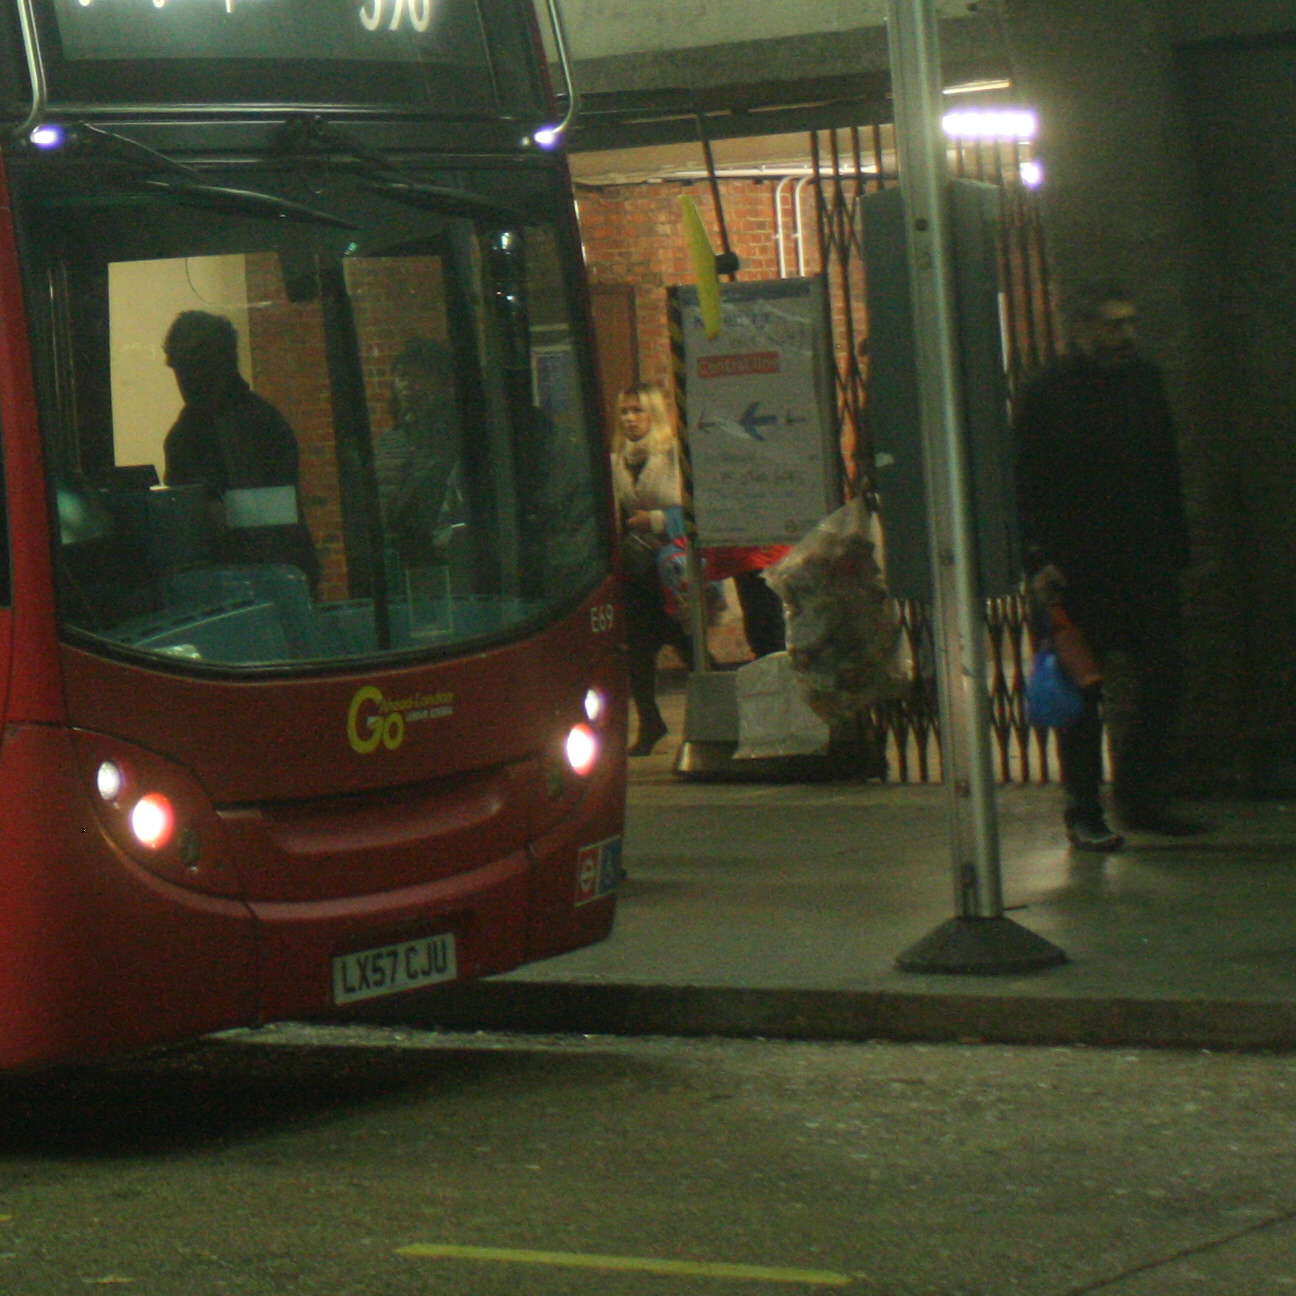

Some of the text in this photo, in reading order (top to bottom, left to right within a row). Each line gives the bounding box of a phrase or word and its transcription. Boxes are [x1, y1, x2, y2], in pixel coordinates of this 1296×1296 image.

[590, 604, 613, 634] E69
[348, 686, 404, 754] Go
[342, 937, 447, 994] LX57 CJU
